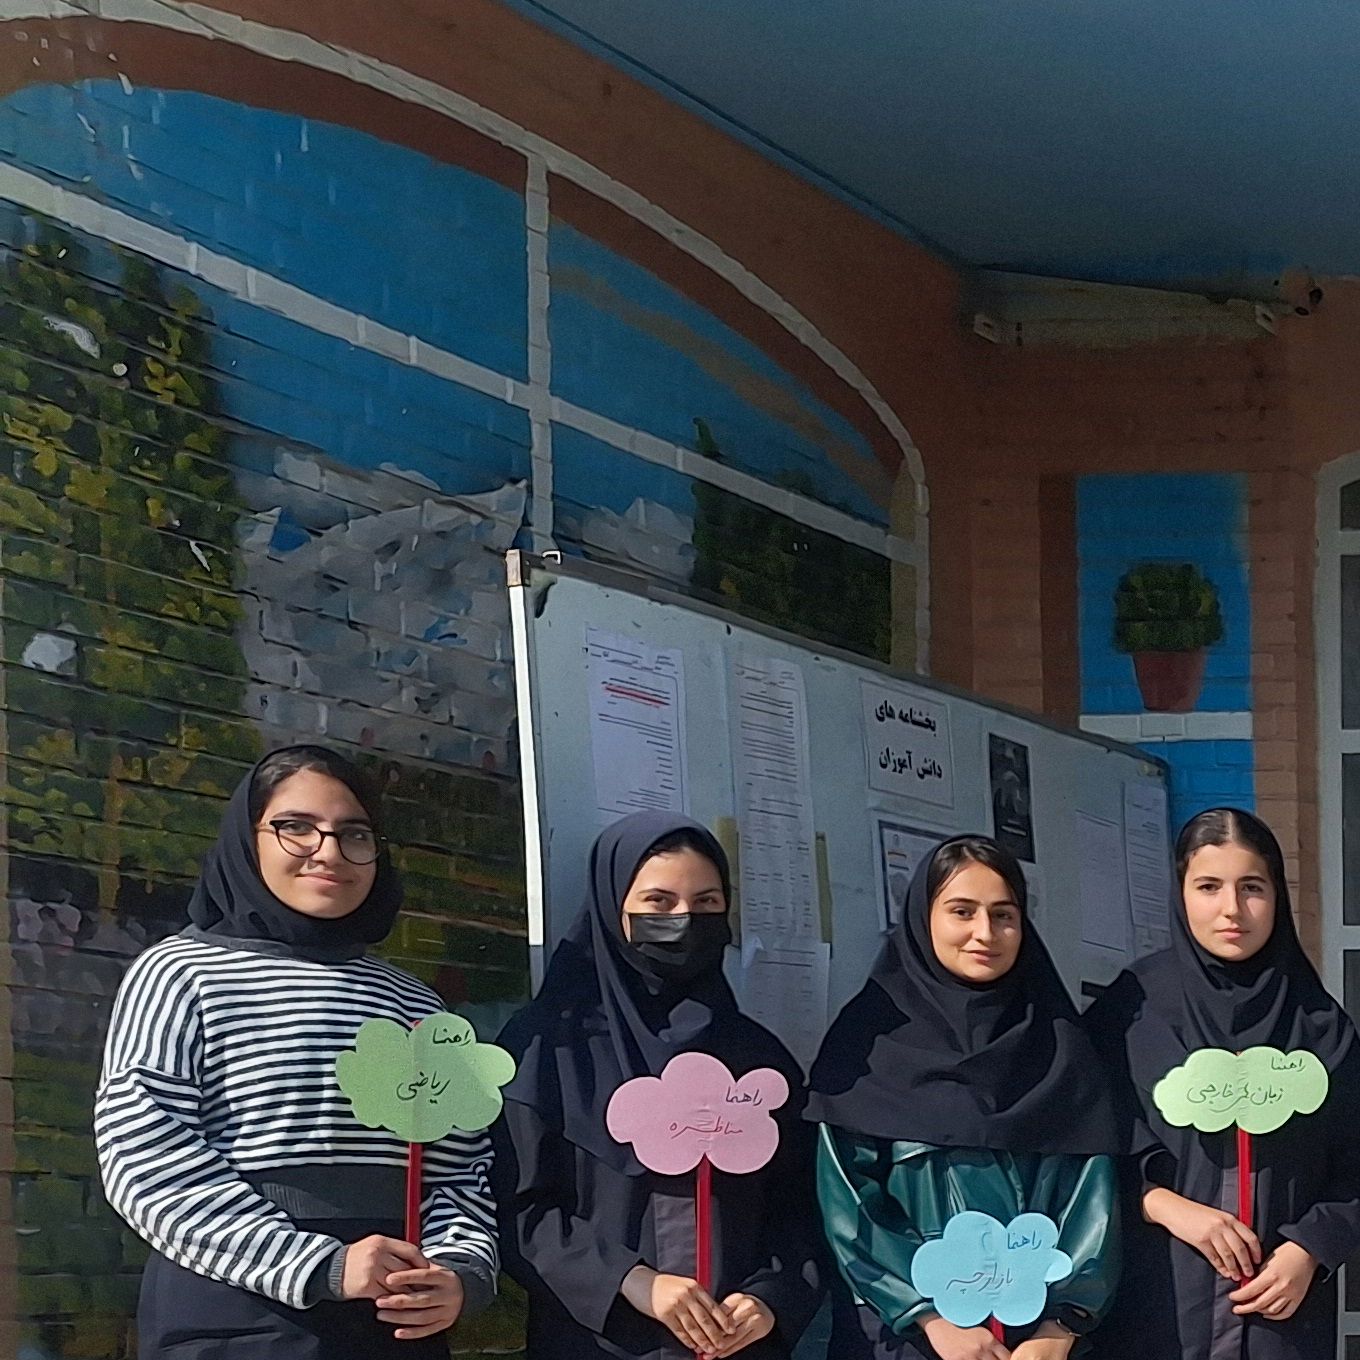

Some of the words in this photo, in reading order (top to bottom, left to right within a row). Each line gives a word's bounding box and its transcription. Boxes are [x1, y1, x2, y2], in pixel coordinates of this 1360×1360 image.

[875, 699, 896, 723] های
[898, 706, 937, 738] بخشنامه
[879, 746, 912, 775] آموزان
[916, 757, 943, 780] دانش
[396, 1070, 451, 1105] ریاضی
[1186, 1082, 1234, 1105] خارجی
[1250, 1084, 1284, 1107] زبان
[669, 1114, 743, 1140] مناظره
